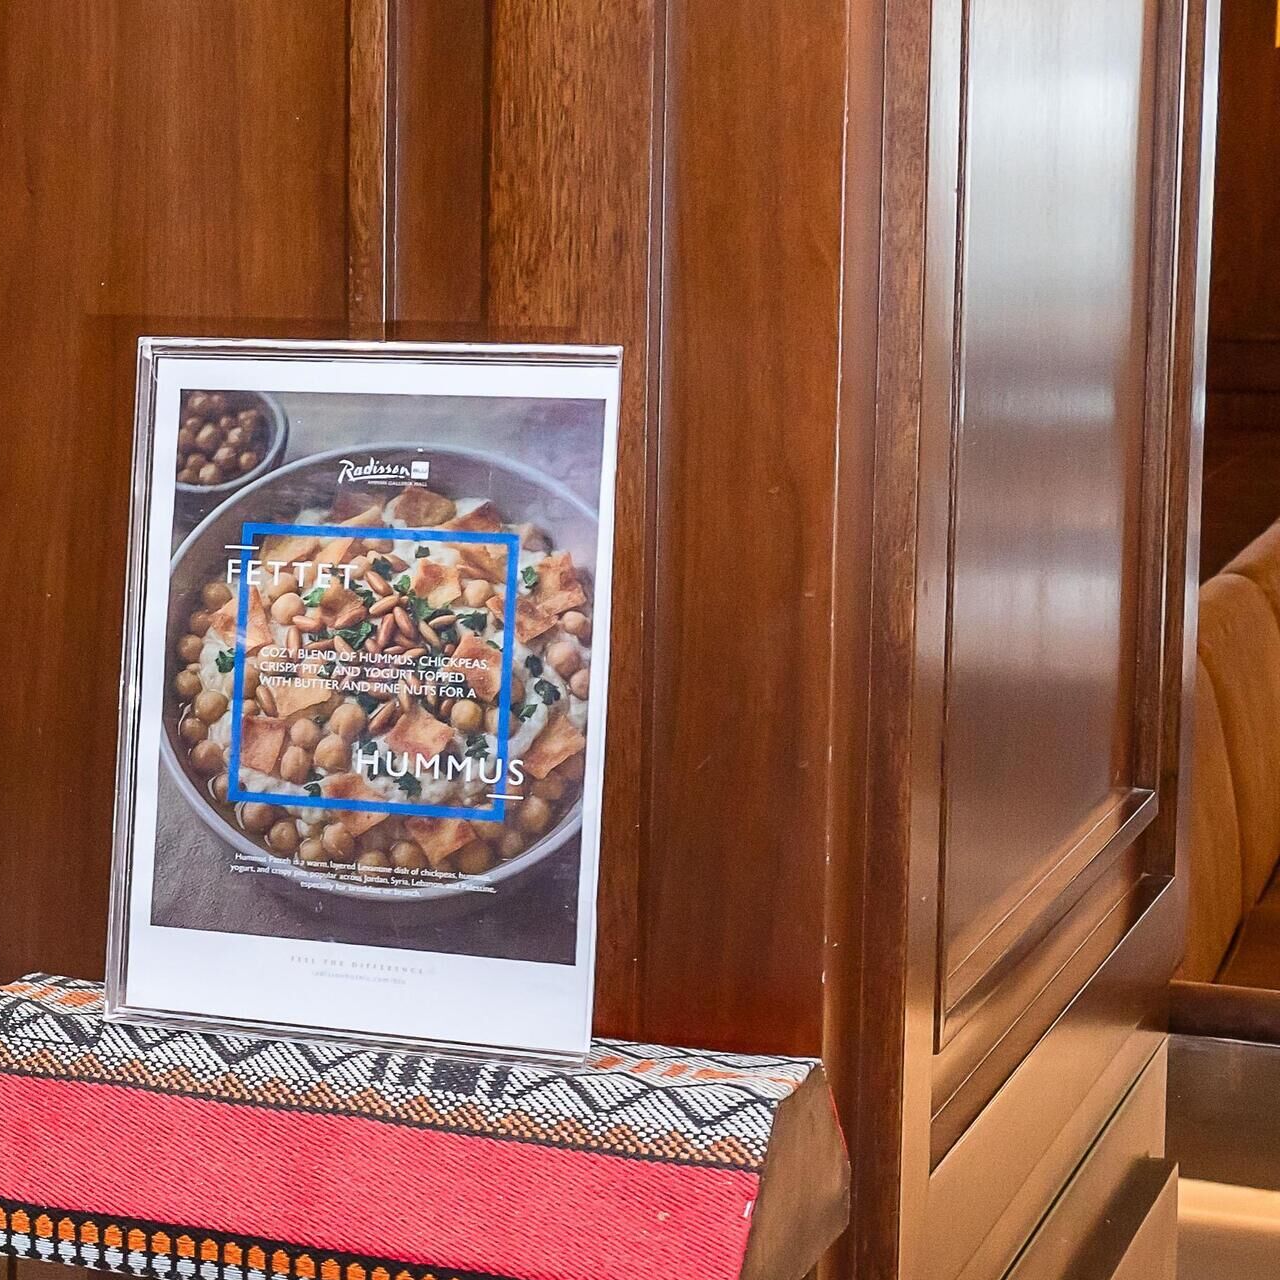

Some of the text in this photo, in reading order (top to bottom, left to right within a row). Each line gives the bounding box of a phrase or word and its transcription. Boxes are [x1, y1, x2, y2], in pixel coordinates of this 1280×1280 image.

[338, 457, 410, 484] Radisson
[227, 559, 358, 589] FETTET
[261, 647, 295, 658] COZY
[298, 649, 336, 660] BLEND
[340, 652, 357, 661] OF
[260, 661, 299, 673] CRISPY
[332, 666, 360, 677] AND
[364, 667, 415, 680] YOGURT
[418, 670, 465, 683] TOPPED
[259, 674, 476, 698] WITH BUTTER AND PINE NUTS FOR A
[356, 749, 524, 786] HUMMUS
[257, 866, 270, 874] and
[394, 866, 409, 875] dish
[410, 867, 420, 876] of
